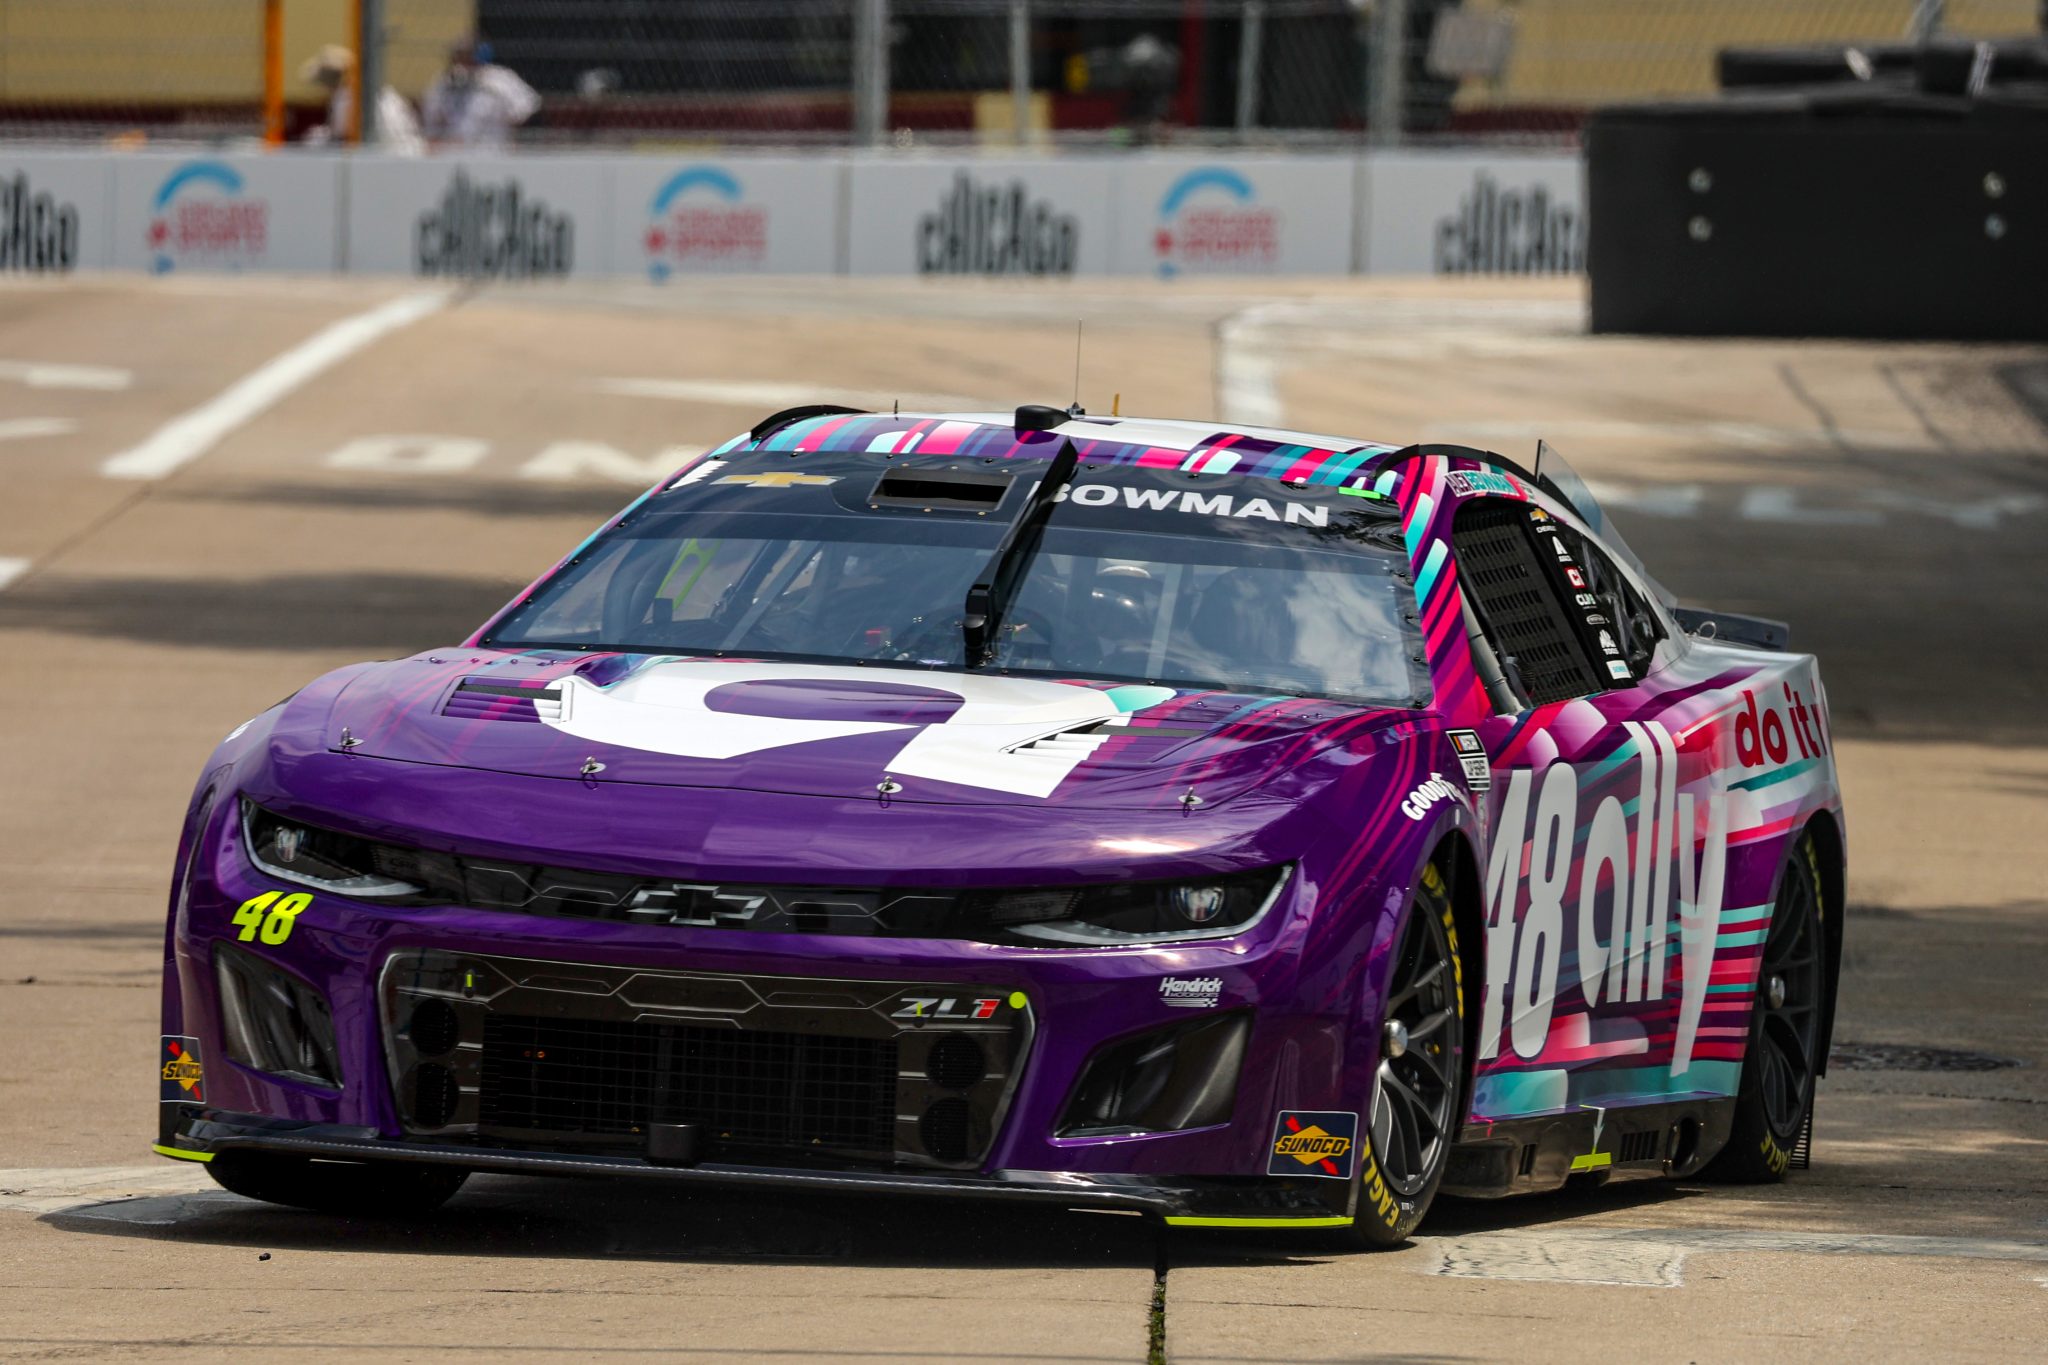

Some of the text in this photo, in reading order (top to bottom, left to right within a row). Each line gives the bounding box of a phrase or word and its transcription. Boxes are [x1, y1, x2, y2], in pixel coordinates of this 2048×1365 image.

[1735, 690, 1788, 768] do
[1783, 681, 1821, 759] it
[1479, 721, 1727, 1077] 48 ally
[231, 890, 315, 946] 48
[1159, 977, 1223, 996] Hendrick
[890, 999, 1001, 1018] ZL1
[1278, 1137, 1346, 1154] SUNOCO
